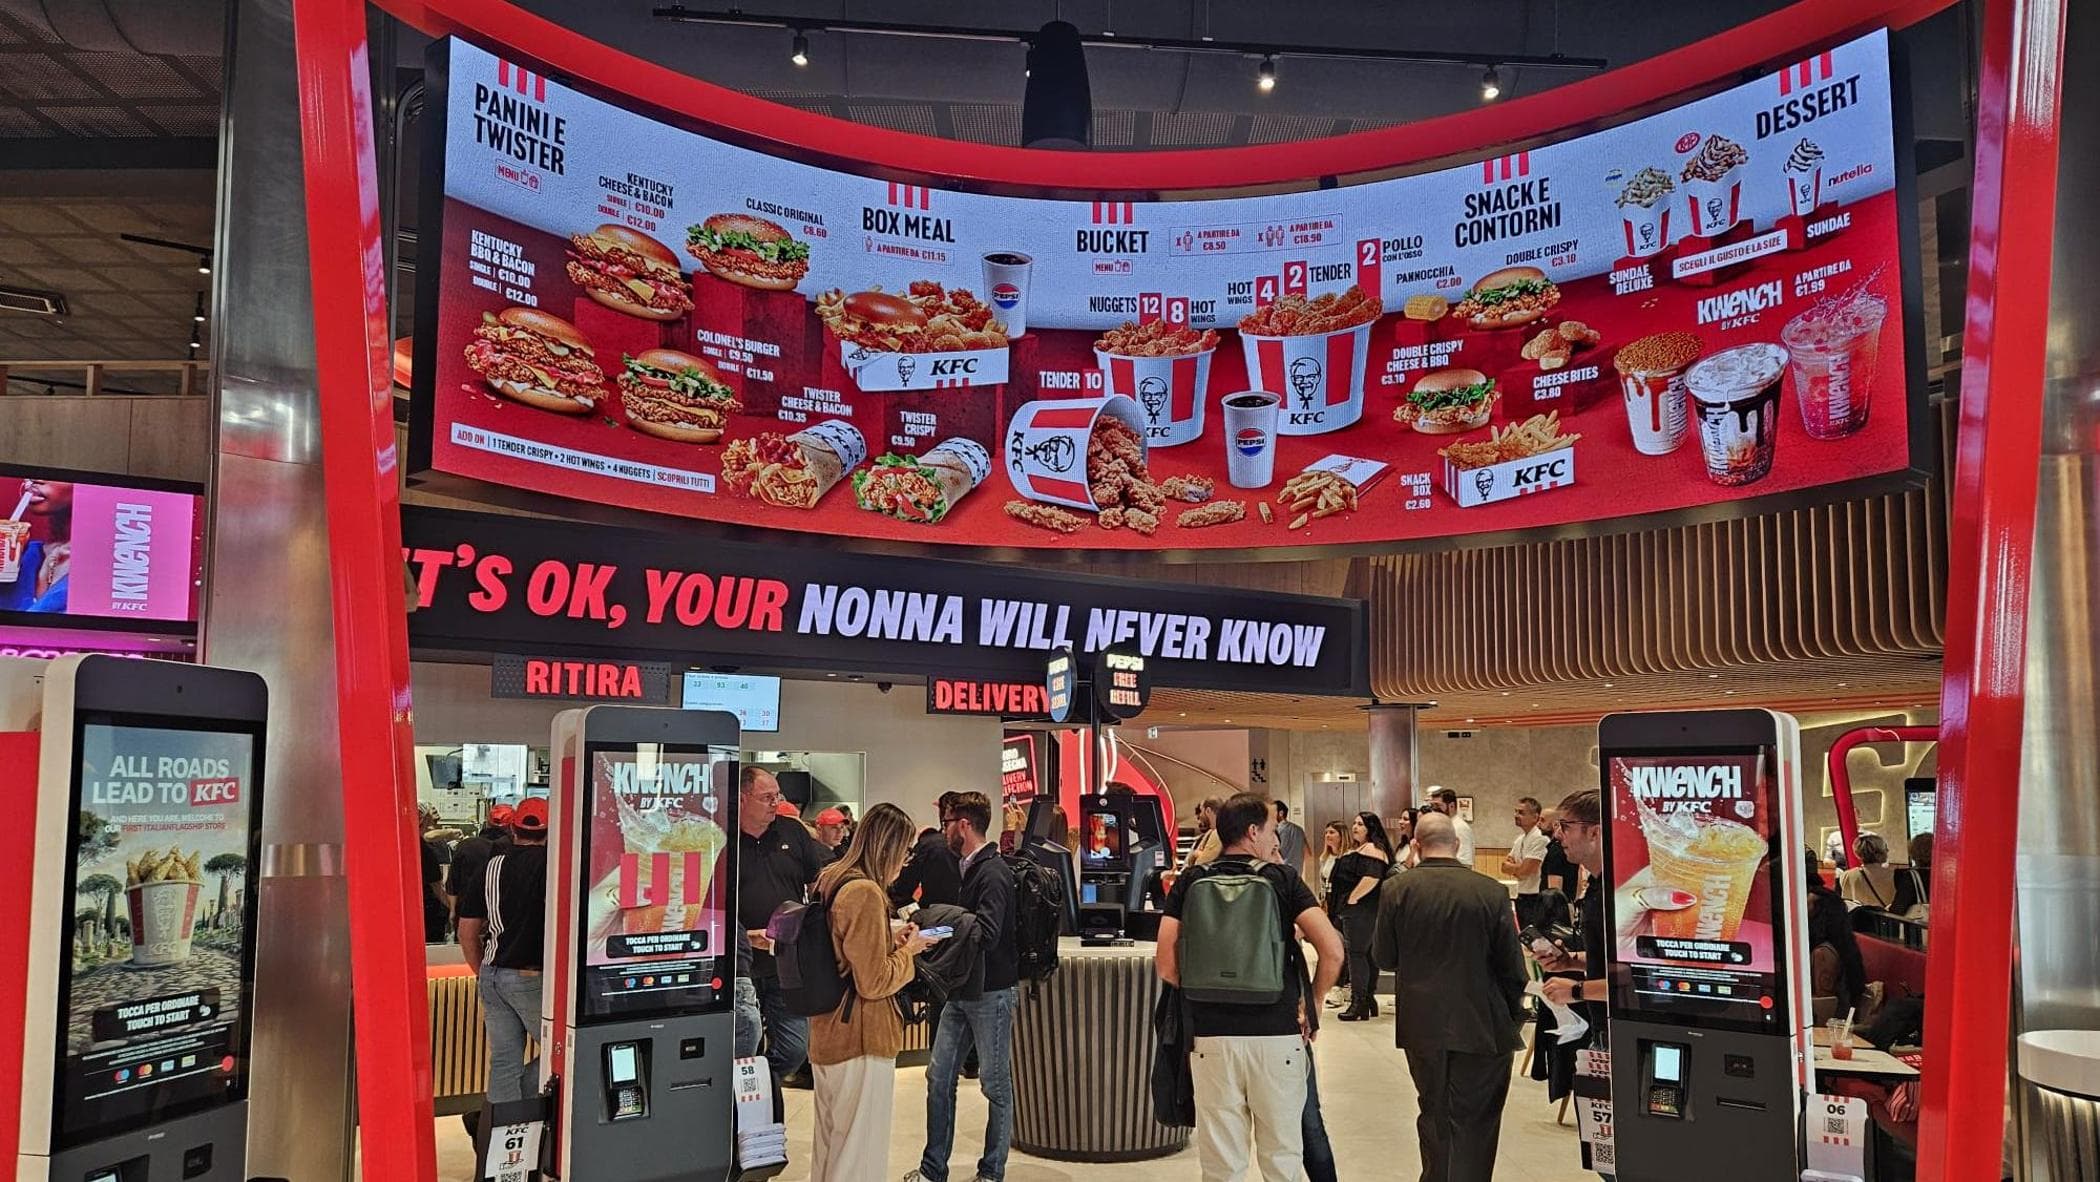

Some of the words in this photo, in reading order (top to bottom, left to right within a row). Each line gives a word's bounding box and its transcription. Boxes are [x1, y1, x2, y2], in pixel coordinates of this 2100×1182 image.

[474, 82, 549, 138] PANINI
[555, 117, 567, 146] E
[1756, 74, 1860, 140] DESSERT
[474, 114, 565, 176] TWISTER
[627, 173, 674, 196] KENTUCKY
[1828, 163, 1873, 187] nutella
[598, 175, 633, 198] CHEESE
[634, 185, 641, 200] &
[641, 188, 674, 209] BACON
[1464, 181, 1535, 219] SNACK
[1539, 177, 1550, 202] E
[746, 198, 783, 218] CLASSIC
[784, 205, 824, 226] ORIGINAL
[862, 207, 902, 236] BOX
[904, 213, 955, 243] MEAL
[1455, 202, 1561, 248] CONTORNI
[1806, 212, 1851, 238] SUNDAE
[471, 229, 523, 258] KENTUCKY
[1076, 229, 1149, 254] BUCKET
[1362, 242, 1376, 266] 2
[1382, 235, 1423, 253] POLLO
[1506, 248, 1542, 266] DOUBLE
[1544, 239, 1579, 257] CRISPY
[470, 241, 491, 264] BBQ
[492, 248, 501, 267] &
[501, 253, 535, 276] BACON
[1679, 256, 1707, 272] SCEGLI
[1716, 245, 1744, 262] GUSTO
[1752, 240, 1762, 253] LA
[1762, 236, 1782, 250] SIZE
[1094, 262, 1114, 273] MENU
[1396, 265, 1455, 284] PANNOCCHIA
[1609, 264, 1650, 286] SUNDAE
[1801, 265, 1835, 284] PARTIRE
[1836, 259, 1851, 273] DA
[1228, 281, 1253, 296] HOT
[1260, 280, 1274, 301] 4
[1289, 265, 1303, 288] 2
[1309, 263, 1351, 283] TENDER
[1436, 277, 1462, 290] €2.00
[1615, 276, 1653, 296] DELUXE
[993, 291, 1019, 301] PEPSI
[1227, 295, 1253, 305] WINGS
[1089, 297, 1137, 313] NUGGETS
[1142, 297, 1159, 314] 12
[1171, 300, 1184, 322] 8
[1191, 300, 1216, 314] HOT
[1190, 314, 1216, 323] WINGS
[1732, 313, 1760, 328] KFC
[697, 330, 744, 350] COLONEL'S
[745, 338, 780, 357] BURGER
[1393, 345, 1429, 360] DOUBLE
[1430, 340, 1464, 355] CRISPY
[930, 358, 978, 377] KFC
[1386, 358, 1420, 373] CHEESE
[1421, 357, 1429, 368] &
[1430, 354, 1449, 367] BBQ
[1039, 371, 1080, 388] TENDER
[1086, 371, 1102, 388] 10
[1533, 373, 1570, 389] CHEESE
[1571, 366, 1599, 383] BITES
[803, 387, 841, 403] TWISTER
[781, 396, 814, 411] CHEESE
[815, 400, 821, 413] &
[821, 401, 852, 417] BACON
[900, 411, 937, 426] TWISTER
[1290, 411, 1325, 426] KFC
[904, 423, 937, 437] CRISPY
[1012, 430, 1025, 474] KFC
[1236, 438, 1266, 448] PEPSI
[457, 428, 473, 443] ADD
[497, 438, 525, 455] TENDER
[527, 444, 553, 461] CRISPY
[566, 452, 580, 467] HOT
[581, 456, 605, 471] WINGS
[619, 464, 651, 479] NUGGETS
[690, 476, 710, 489] TUTTI
[1400, 473, 1431, 486] SNACK
[1512, 459, 1566, 488] KFC
[1413, 484, 1431, 497] BOX
[121, 602, 148, 611] KFC
[402, 544, 513, 614] T'S
[527, 560, 628, 630] OK,
[645, 569, 789, 632] YOUR
[798, 583, 963, 644] NONNA
[979, 598, 1074, 651] WILL
[1084, 608, 1210, 660] NEVER
[1217, 619, 1326, 668] KNOW
[526, 660, 642, 698] RITIRA
[934, 680, 1050, 713] DELIVERY
[109, 755, 153, 778] ALL
[158, 756, 229, 779] ROADS
[93, 782, 154, 804] LEAD
[157, 782, 187, 804] TO
[194, 782, 236, 802] KFC
[652, 797, 683, 809] KFC
[1662, 801, 1676, 812] BY
[1677, 801, 1712, 813] KFC
[626, 936, 646, 945] TOCCA
[632, 945, 654, 953] TOUCH
[655, 944, 663, 952] TO
[664, 942, 683, 951] START
[117, 1004, 144, 1019] TOCCA
[145, 1001, 161, 1014] PER
[127, 1017, 154, 1031] TOUCH
[154, 1015, 165, 1026] TO
[165, 1009, 191, 1025] START
[741, 1065, 754, 1075] 58
[1592, 1110, 1612, 1123] 57
[1827, 1104, 1845, 1116] 06
[505, 1126, 529, 1136] KFC
[504, 1137, 525, 1150] 61
